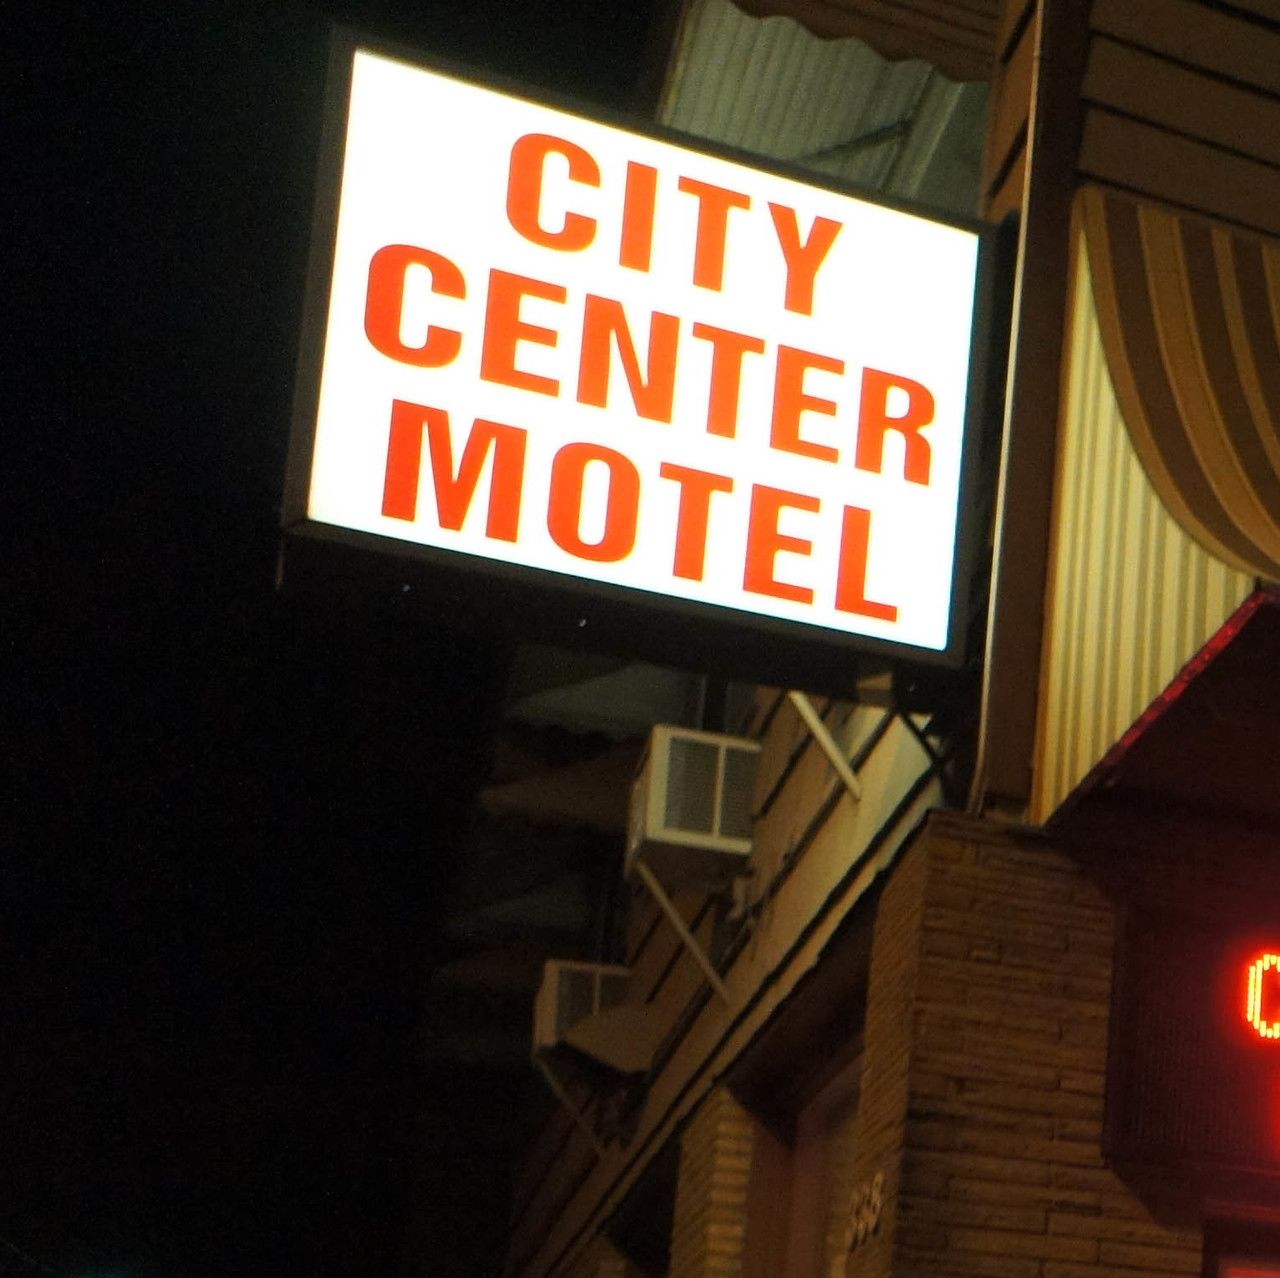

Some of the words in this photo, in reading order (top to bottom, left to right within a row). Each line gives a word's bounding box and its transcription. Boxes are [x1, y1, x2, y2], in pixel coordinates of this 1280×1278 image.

[505, 132, 843, 317] CITY
[363, 243, 936, 486] CENTER
[380, 398, 898, 623] MOTEL
